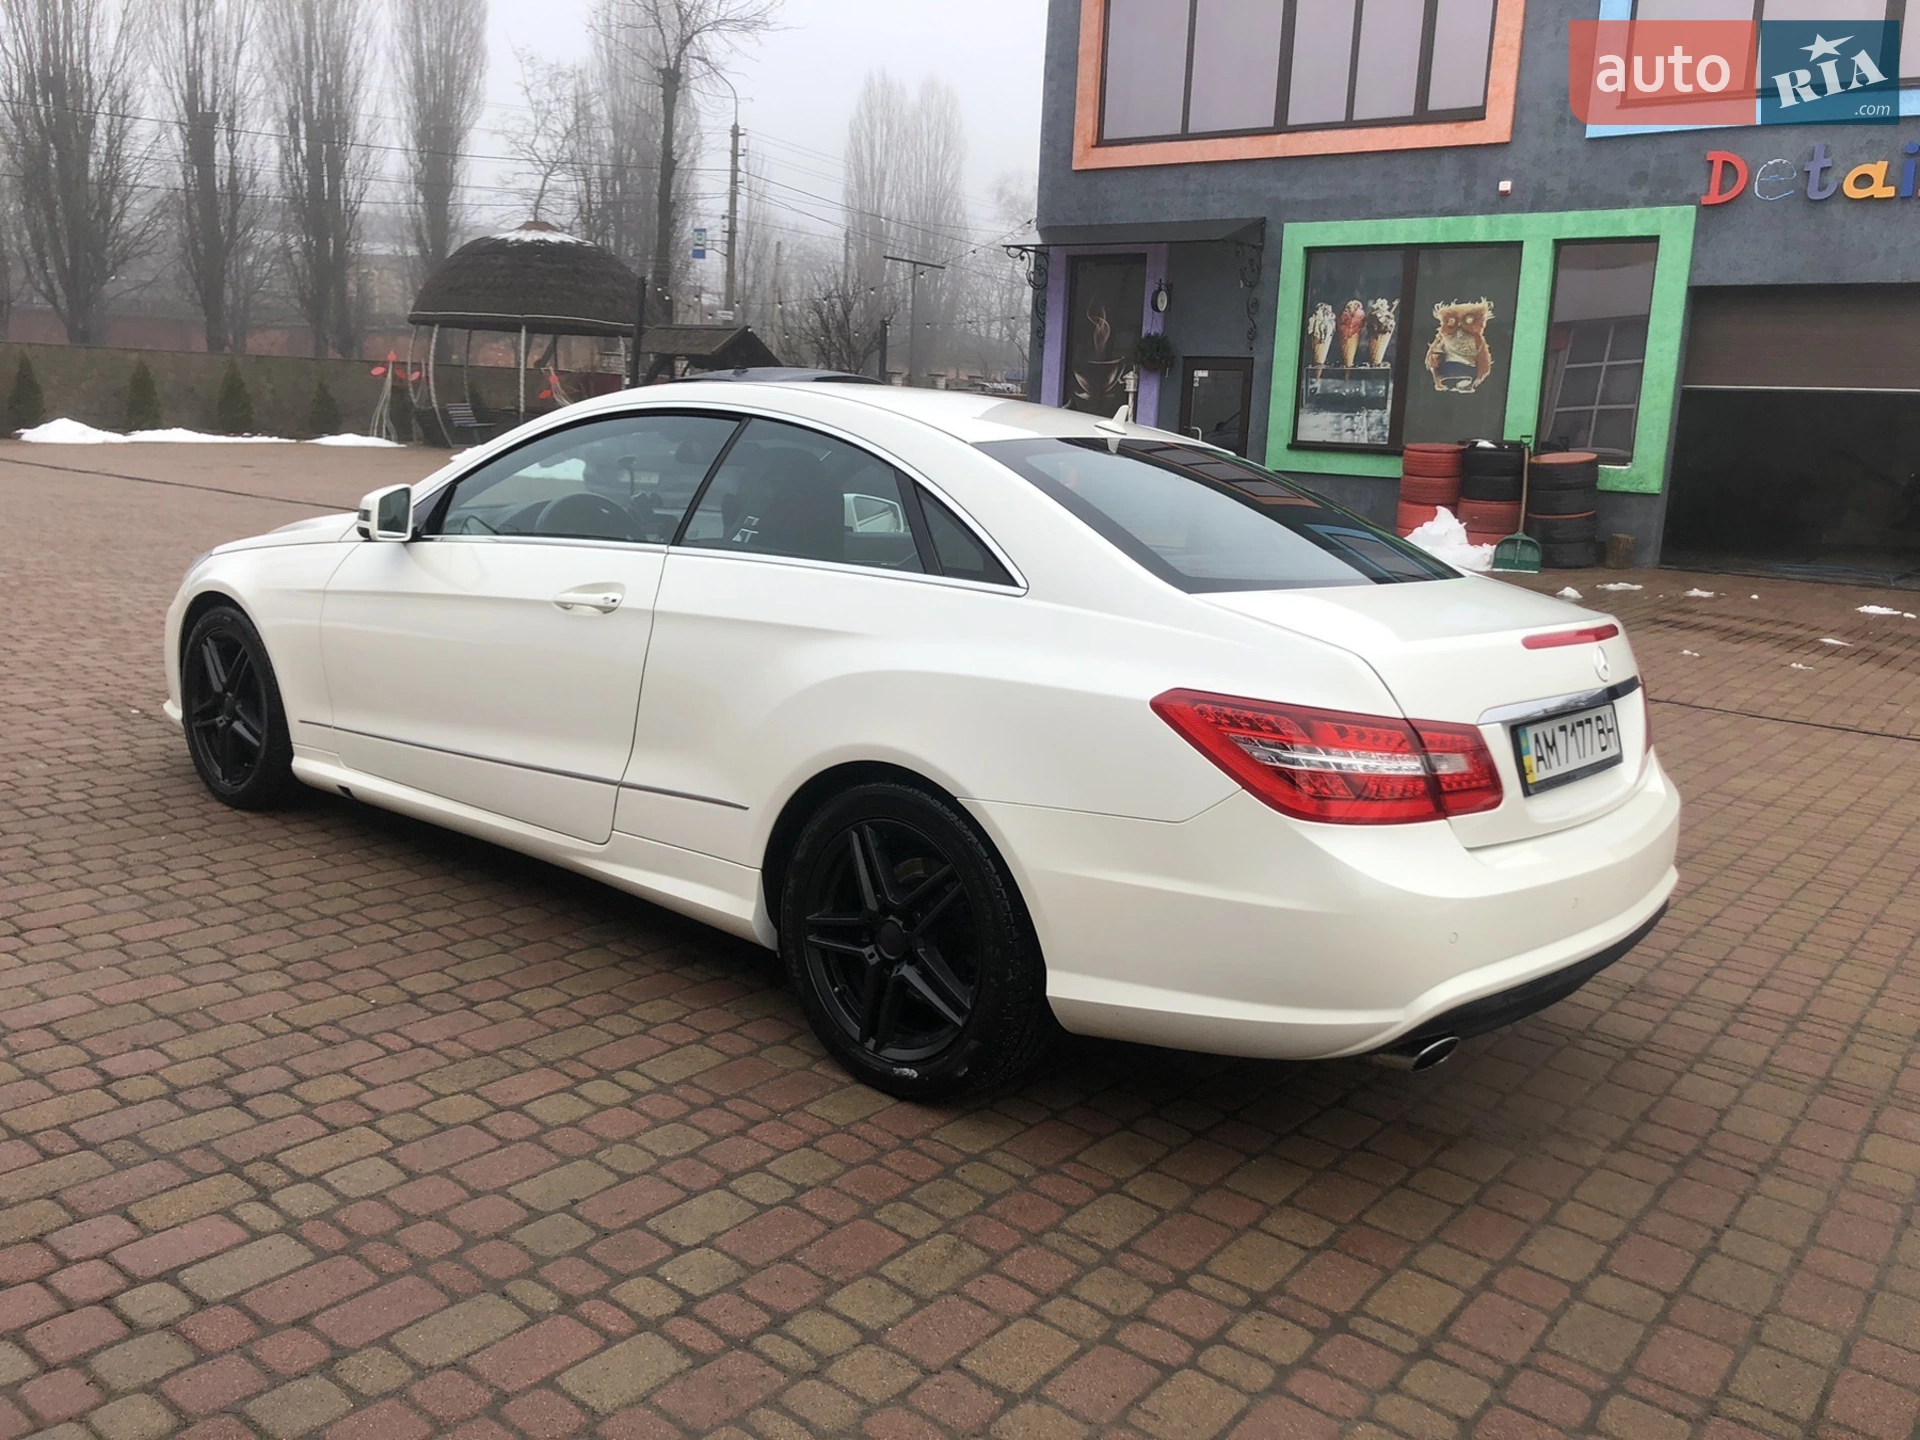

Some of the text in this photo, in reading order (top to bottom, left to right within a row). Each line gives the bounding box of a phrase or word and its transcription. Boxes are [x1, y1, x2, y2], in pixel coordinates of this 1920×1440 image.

[1700, 141, 1920, 206] Detai
[1533, 711, 1618, 773] AM 7177 BH
